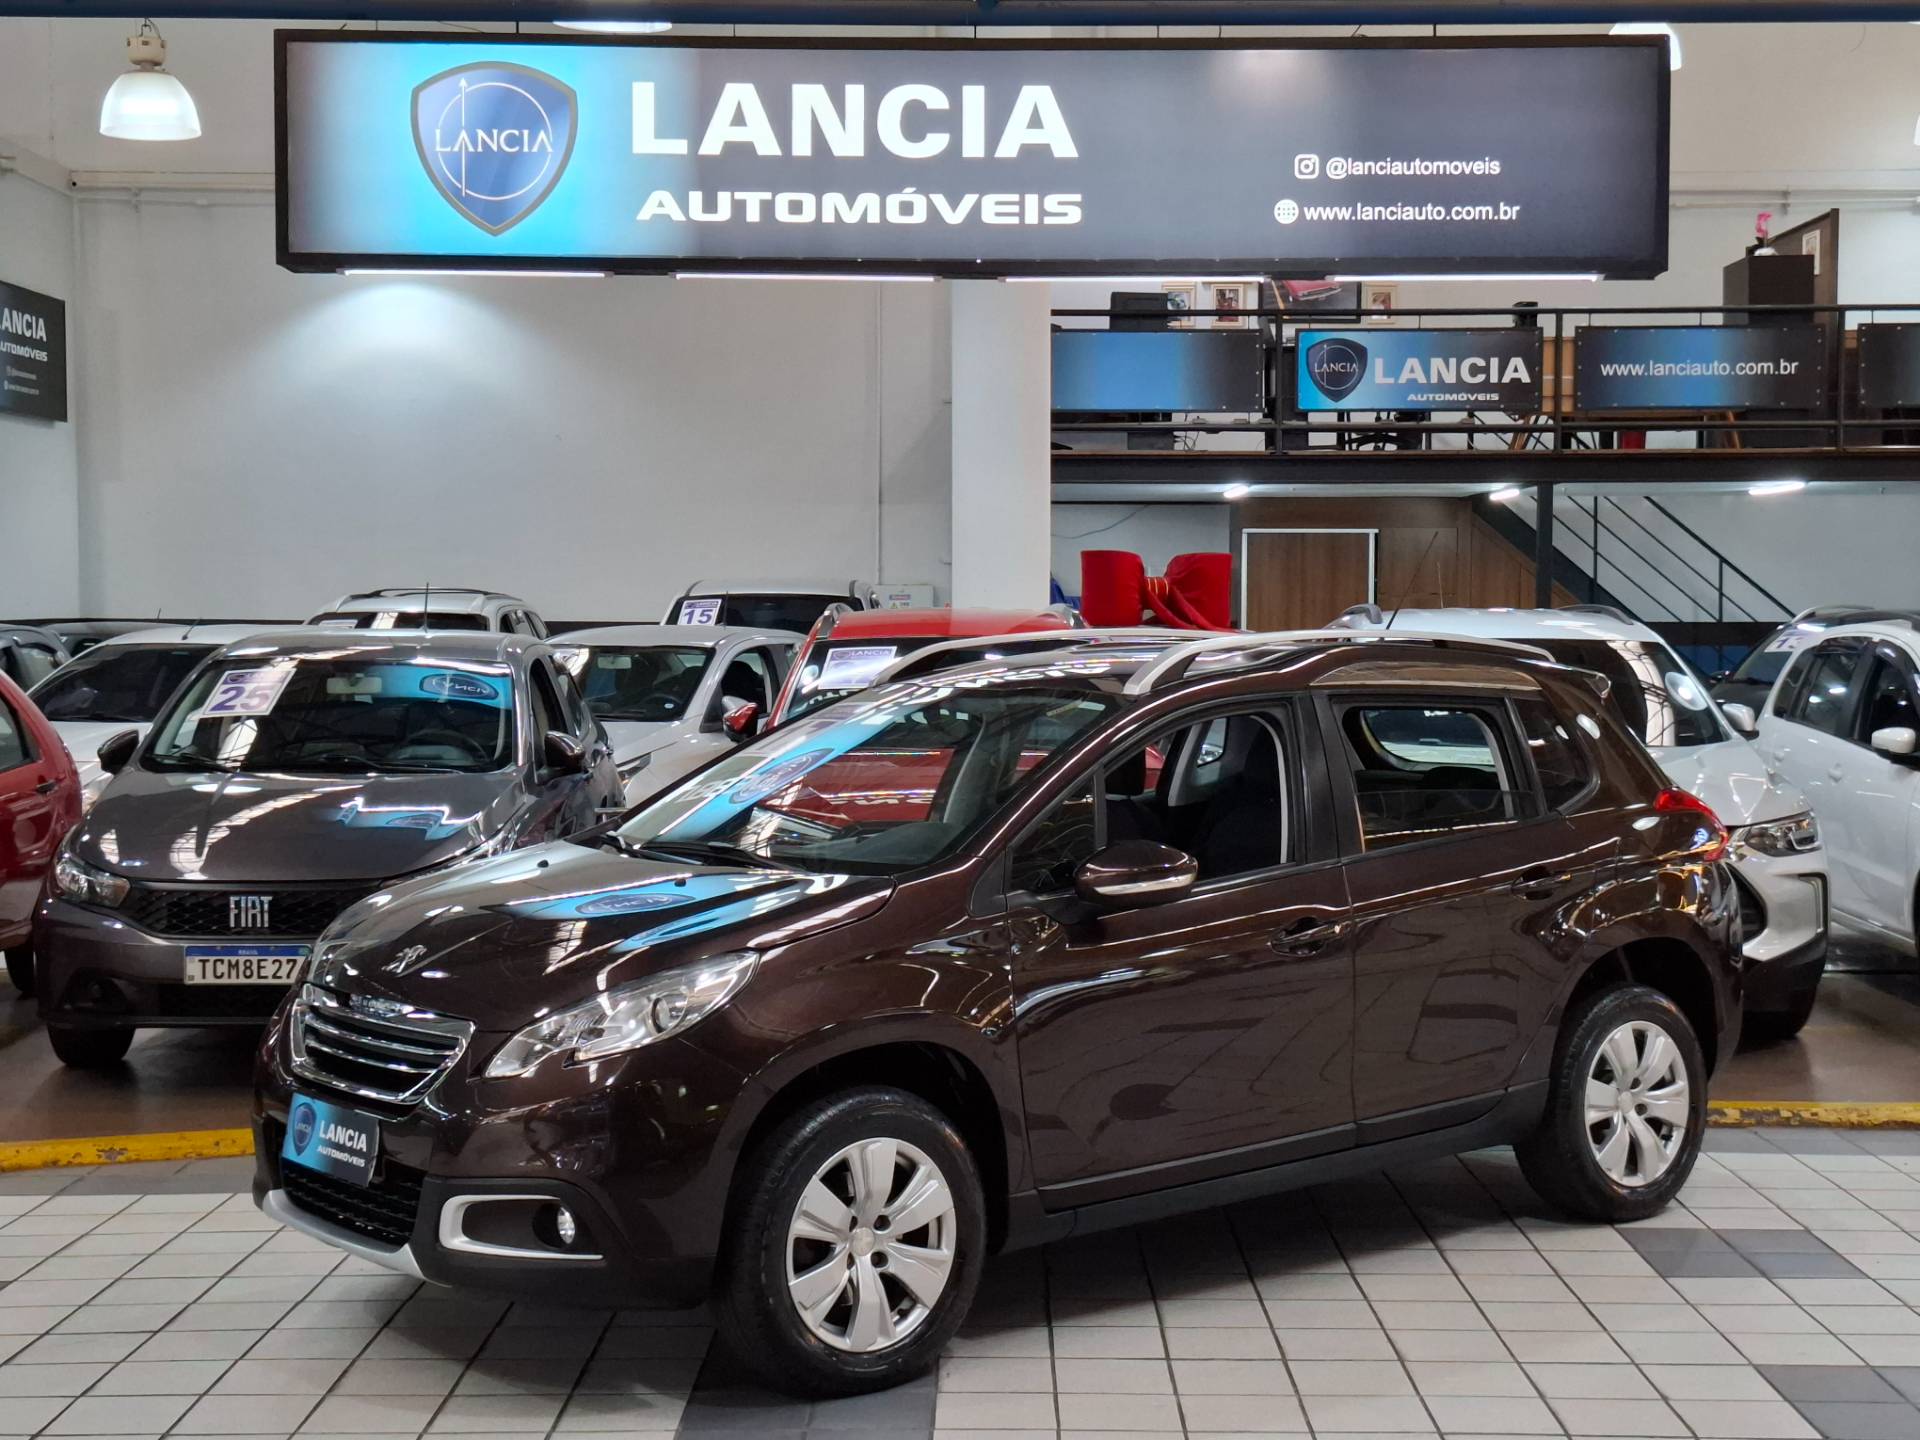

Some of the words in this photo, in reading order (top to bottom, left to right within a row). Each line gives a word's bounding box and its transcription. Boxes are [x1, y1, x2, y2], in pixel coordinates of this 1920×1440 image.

[632, 81, 1079, 158] LANCIA
[435, 128, 553, 152] LANCIA
[1326, 157, 1501, 179] @lanciautomoveis
[636, 187, 1083, 225] AUTOMÓVEIS
[1304, 203, 1521, 221] www.lanciauto.com.br
[0, 307, 47, 342] ANCIA
[0, 341, 48, 362] UTOMÓVEIS
[1314, 361, 1358, 373] LANCIA
[1374, 357, 1531, 384] LANCIA
[1600, 359, 1799, 377] www.lanciauto.com.br
[1407, 392, 1499, 401] AUTOMÓVEIS
[684, 609, 714, 624] 15
[209, 686, 270, 711] 25
[229, 896, 273, 928] FIAT
[198, 959, 298, 980] TCM8E27
[319, 1120, 367, 1152] LANCIA
